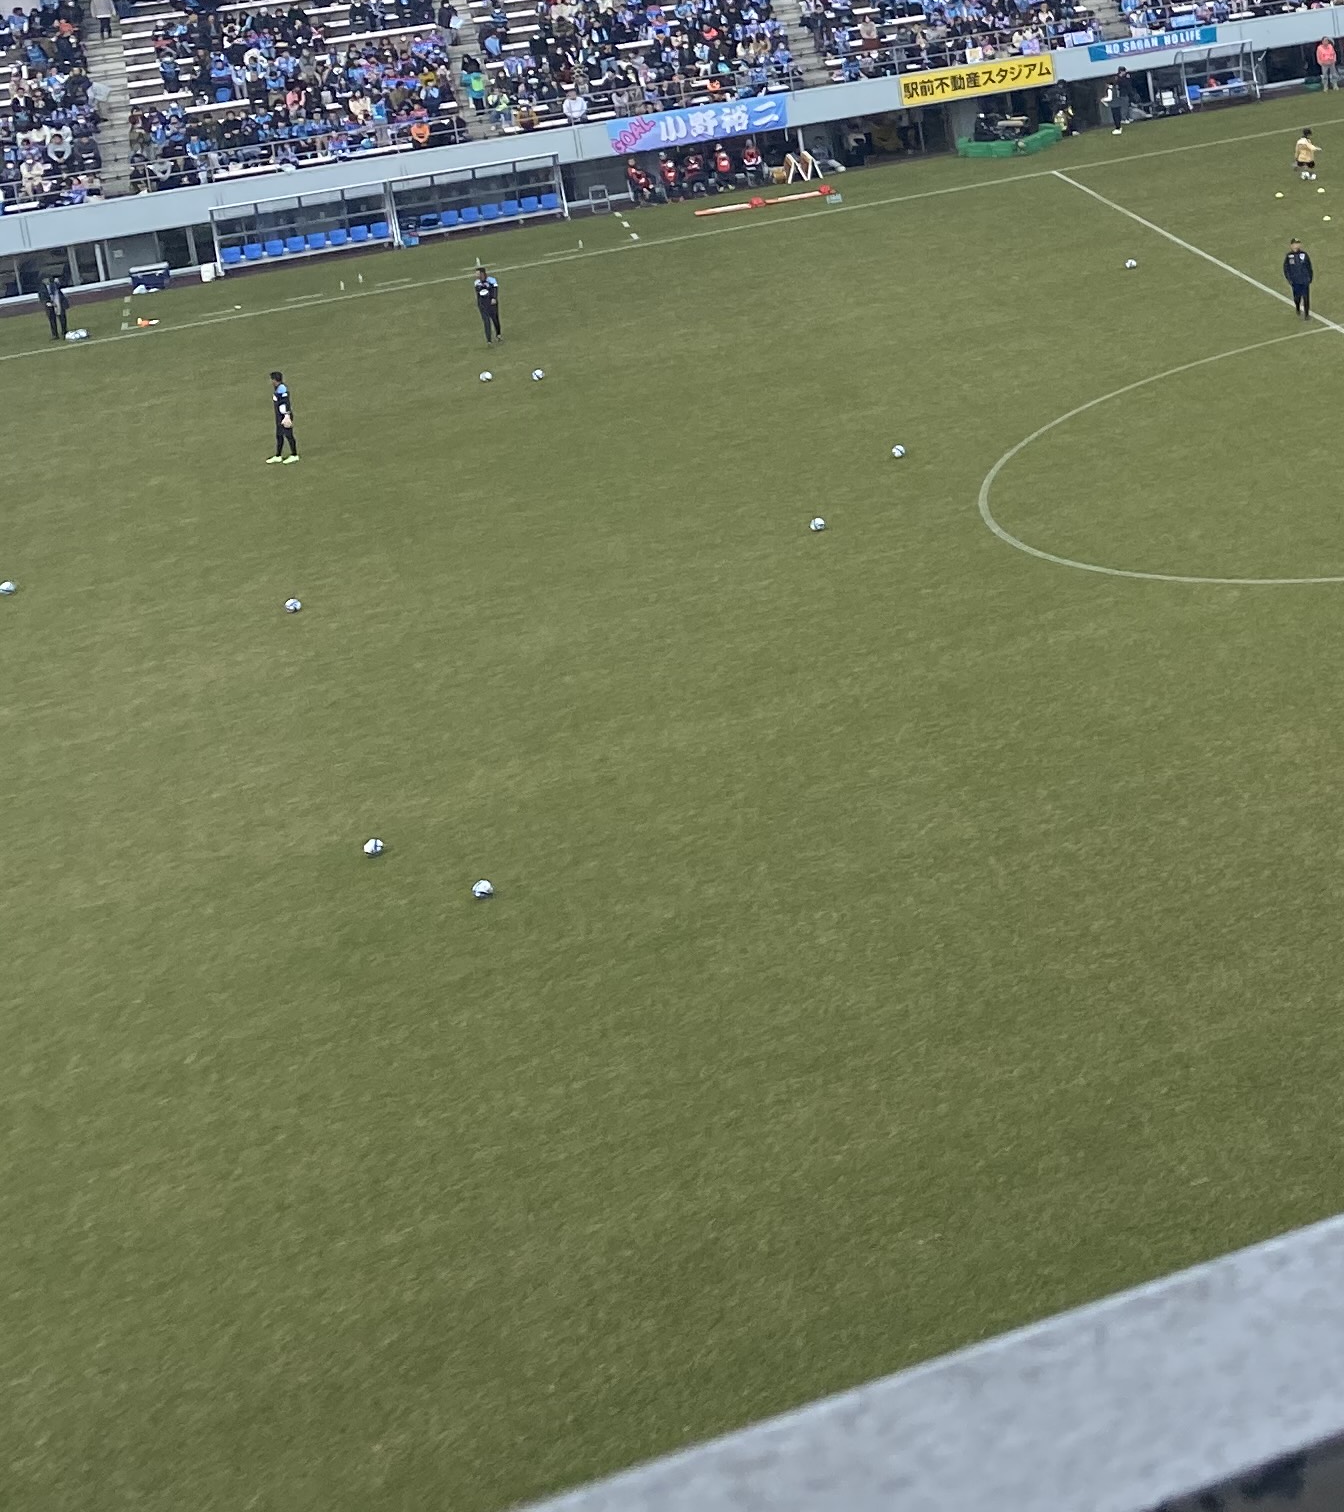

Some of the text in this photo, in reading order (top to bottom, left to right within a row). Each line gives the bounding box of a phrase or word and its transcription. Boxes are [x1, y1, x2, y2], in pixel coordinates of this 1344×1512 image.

[903, 61, 1052, 100] 駅前不動産スタジアム
